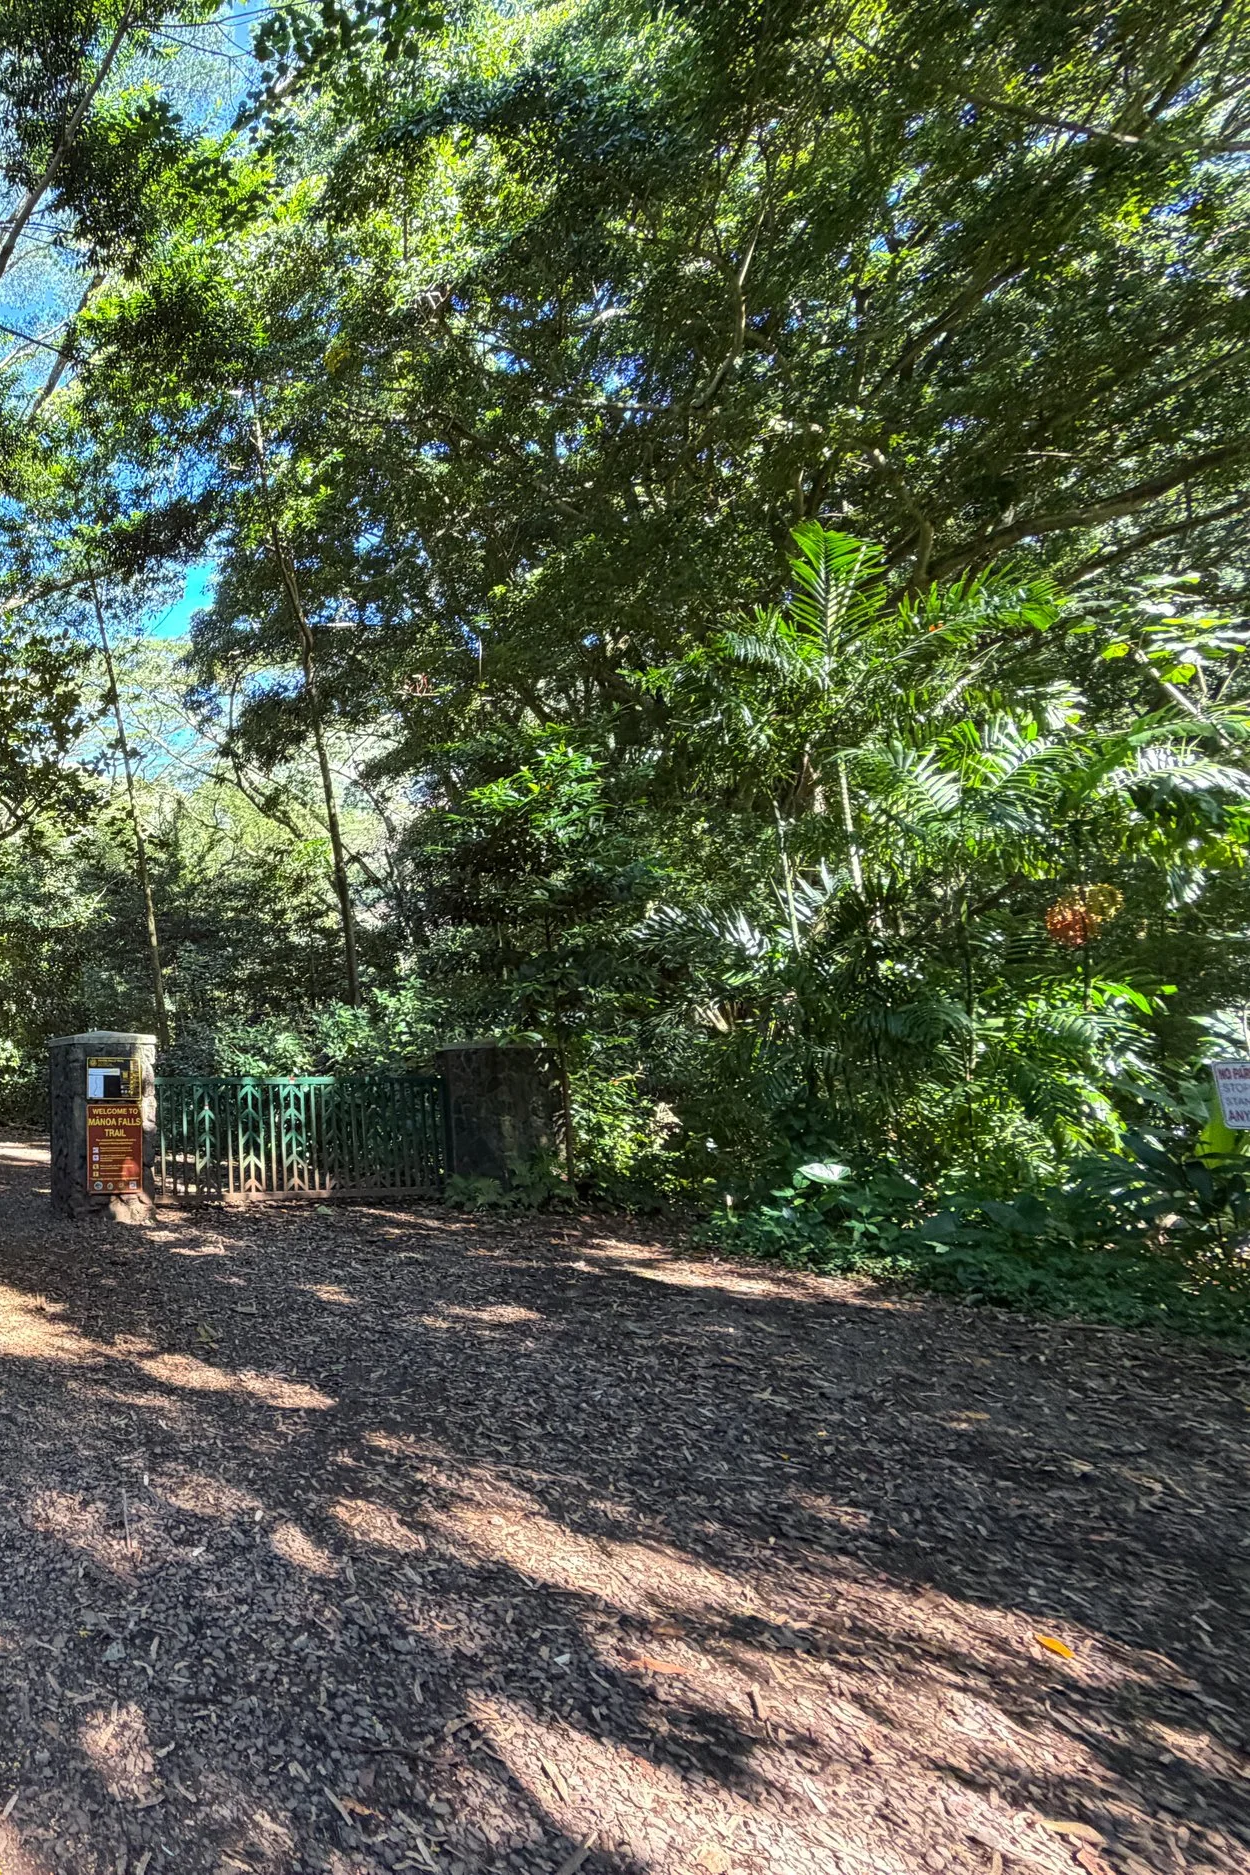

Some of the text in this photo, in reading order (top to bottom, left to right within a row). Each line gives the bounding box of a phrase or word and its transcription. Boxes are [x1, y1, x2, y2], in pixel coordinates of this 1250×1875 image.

[1217, 1068, 1231, 1079] NO
[118, 1117, 141, 1126] FALLS
[104, 1129, 126, 1137] TRAIL
